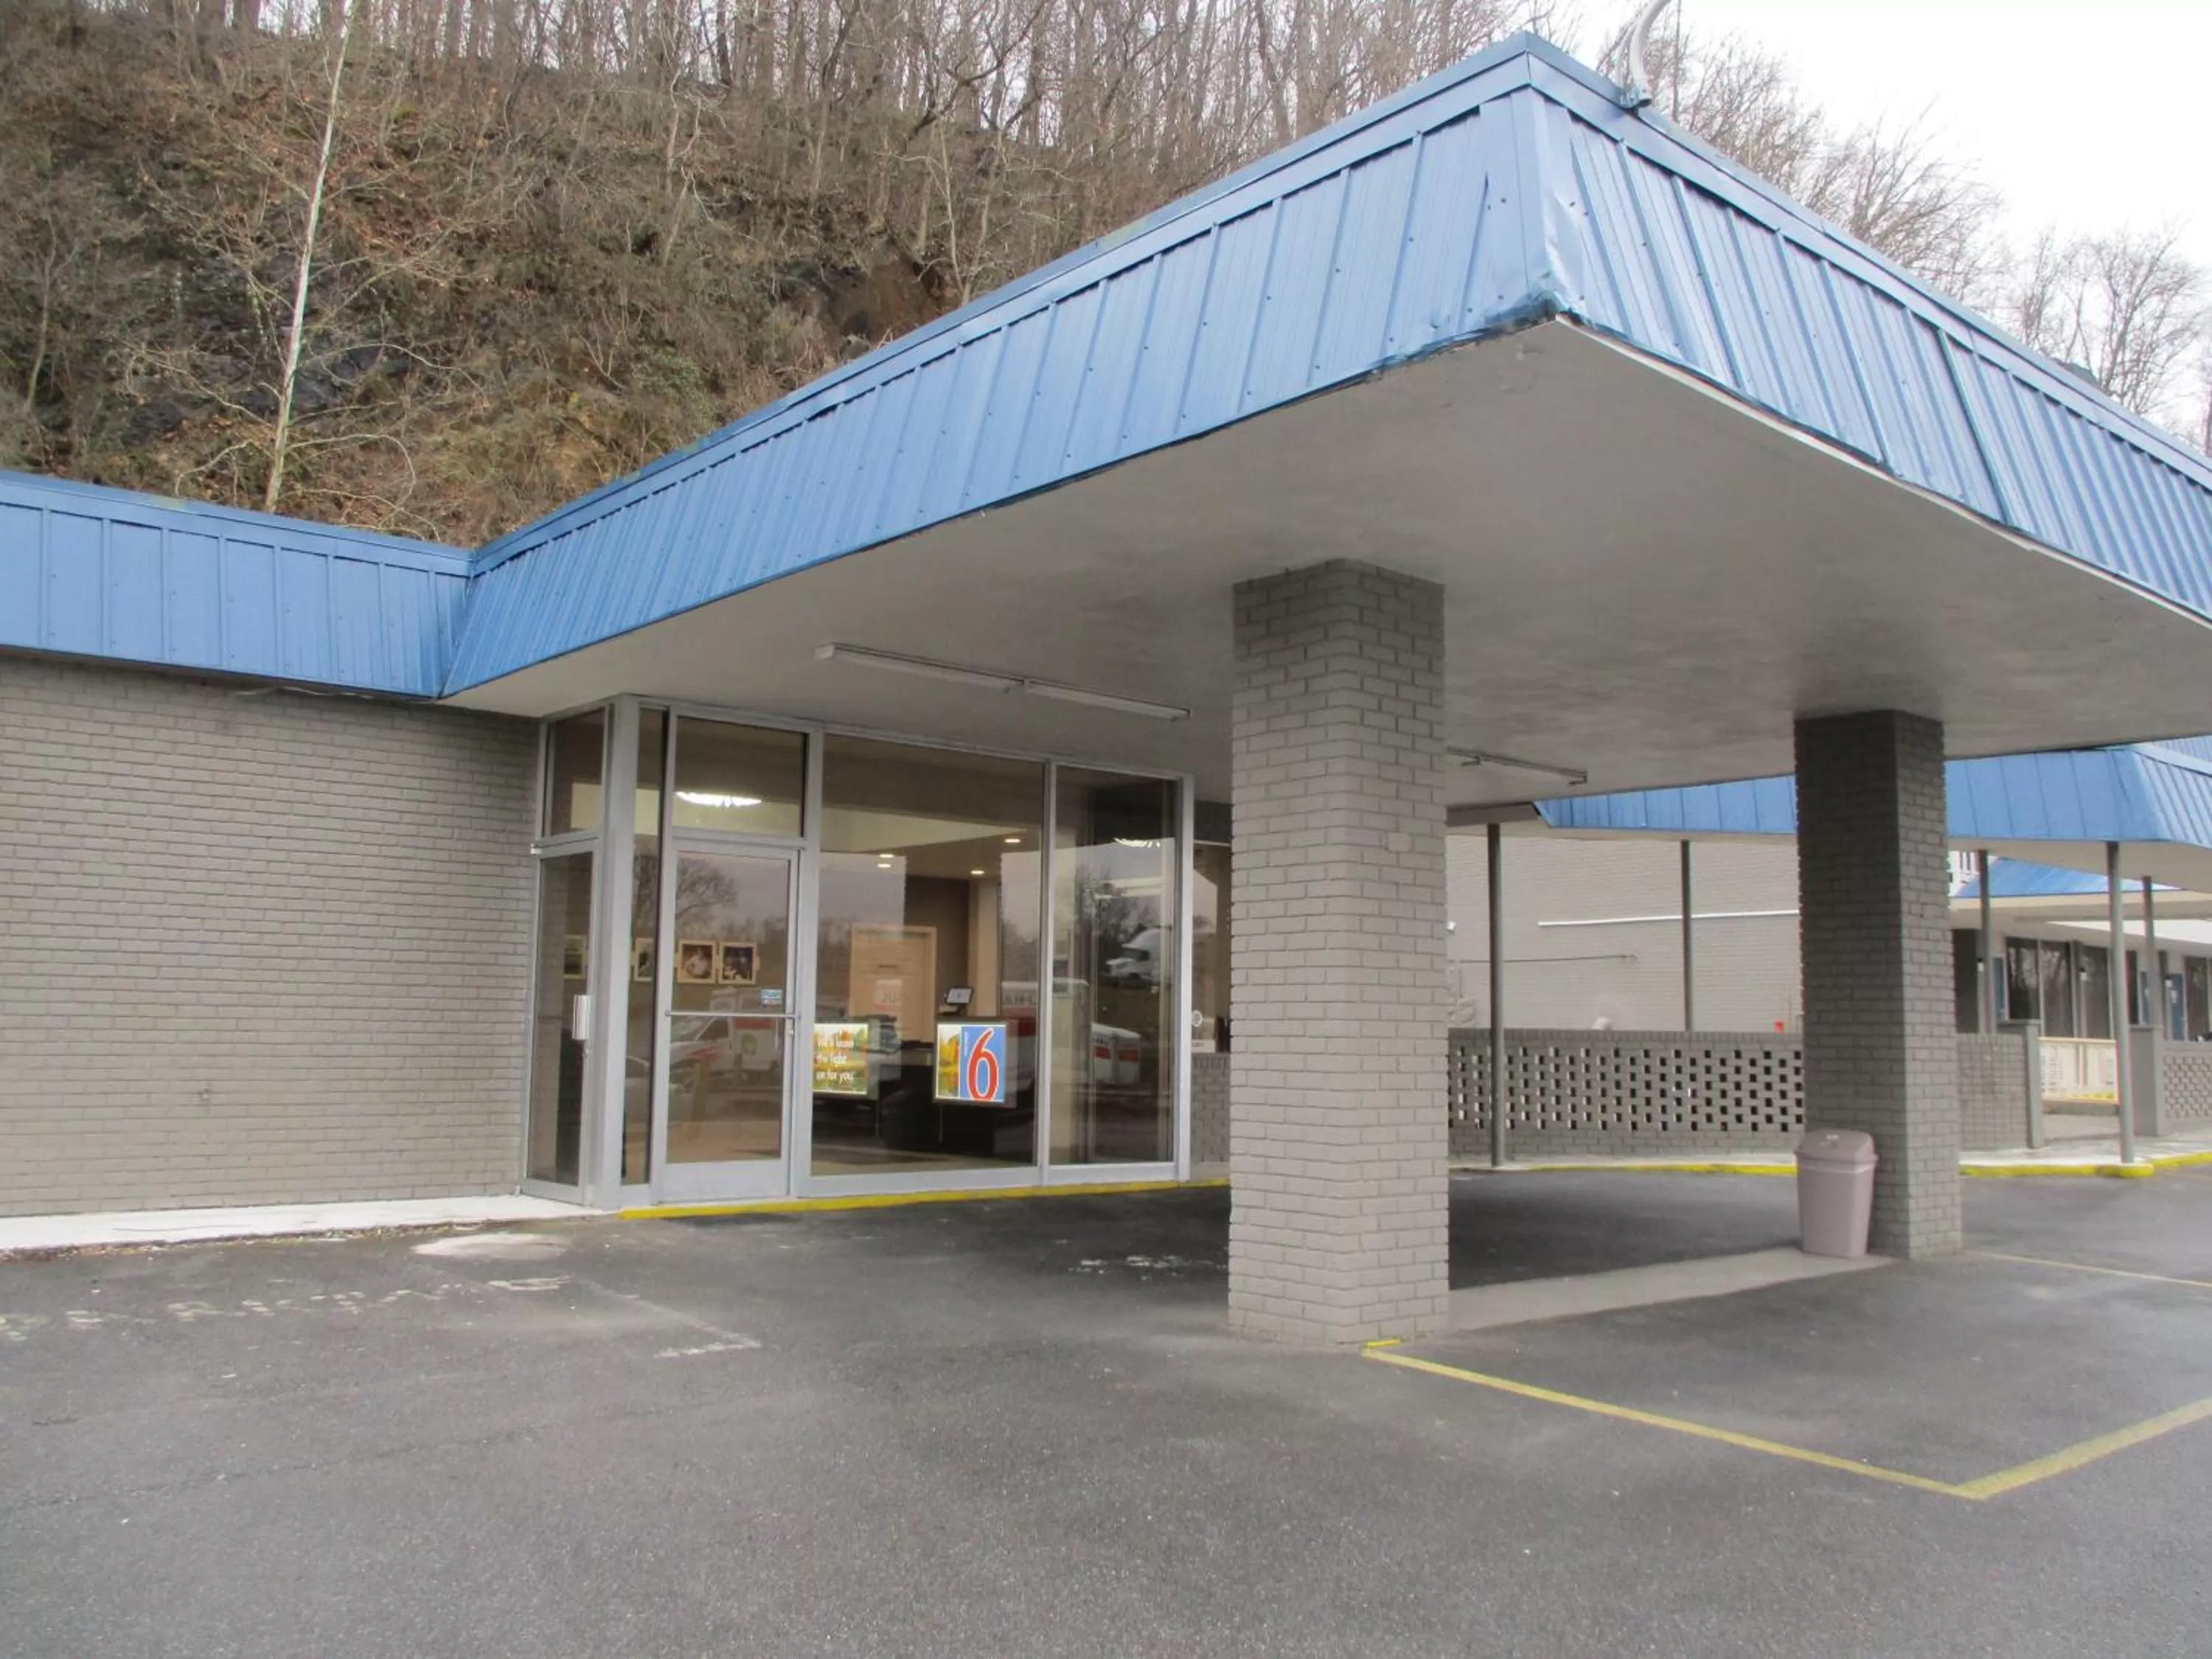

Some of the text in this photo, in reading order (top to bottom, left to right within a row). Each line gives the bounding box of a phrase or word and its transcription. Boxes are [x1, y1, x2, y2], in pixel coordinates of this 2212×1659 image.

[816, 1071, 825, 1080] on
[826, 1069, 838, 1080] for
[967, 1027, 999, 1101] 6
